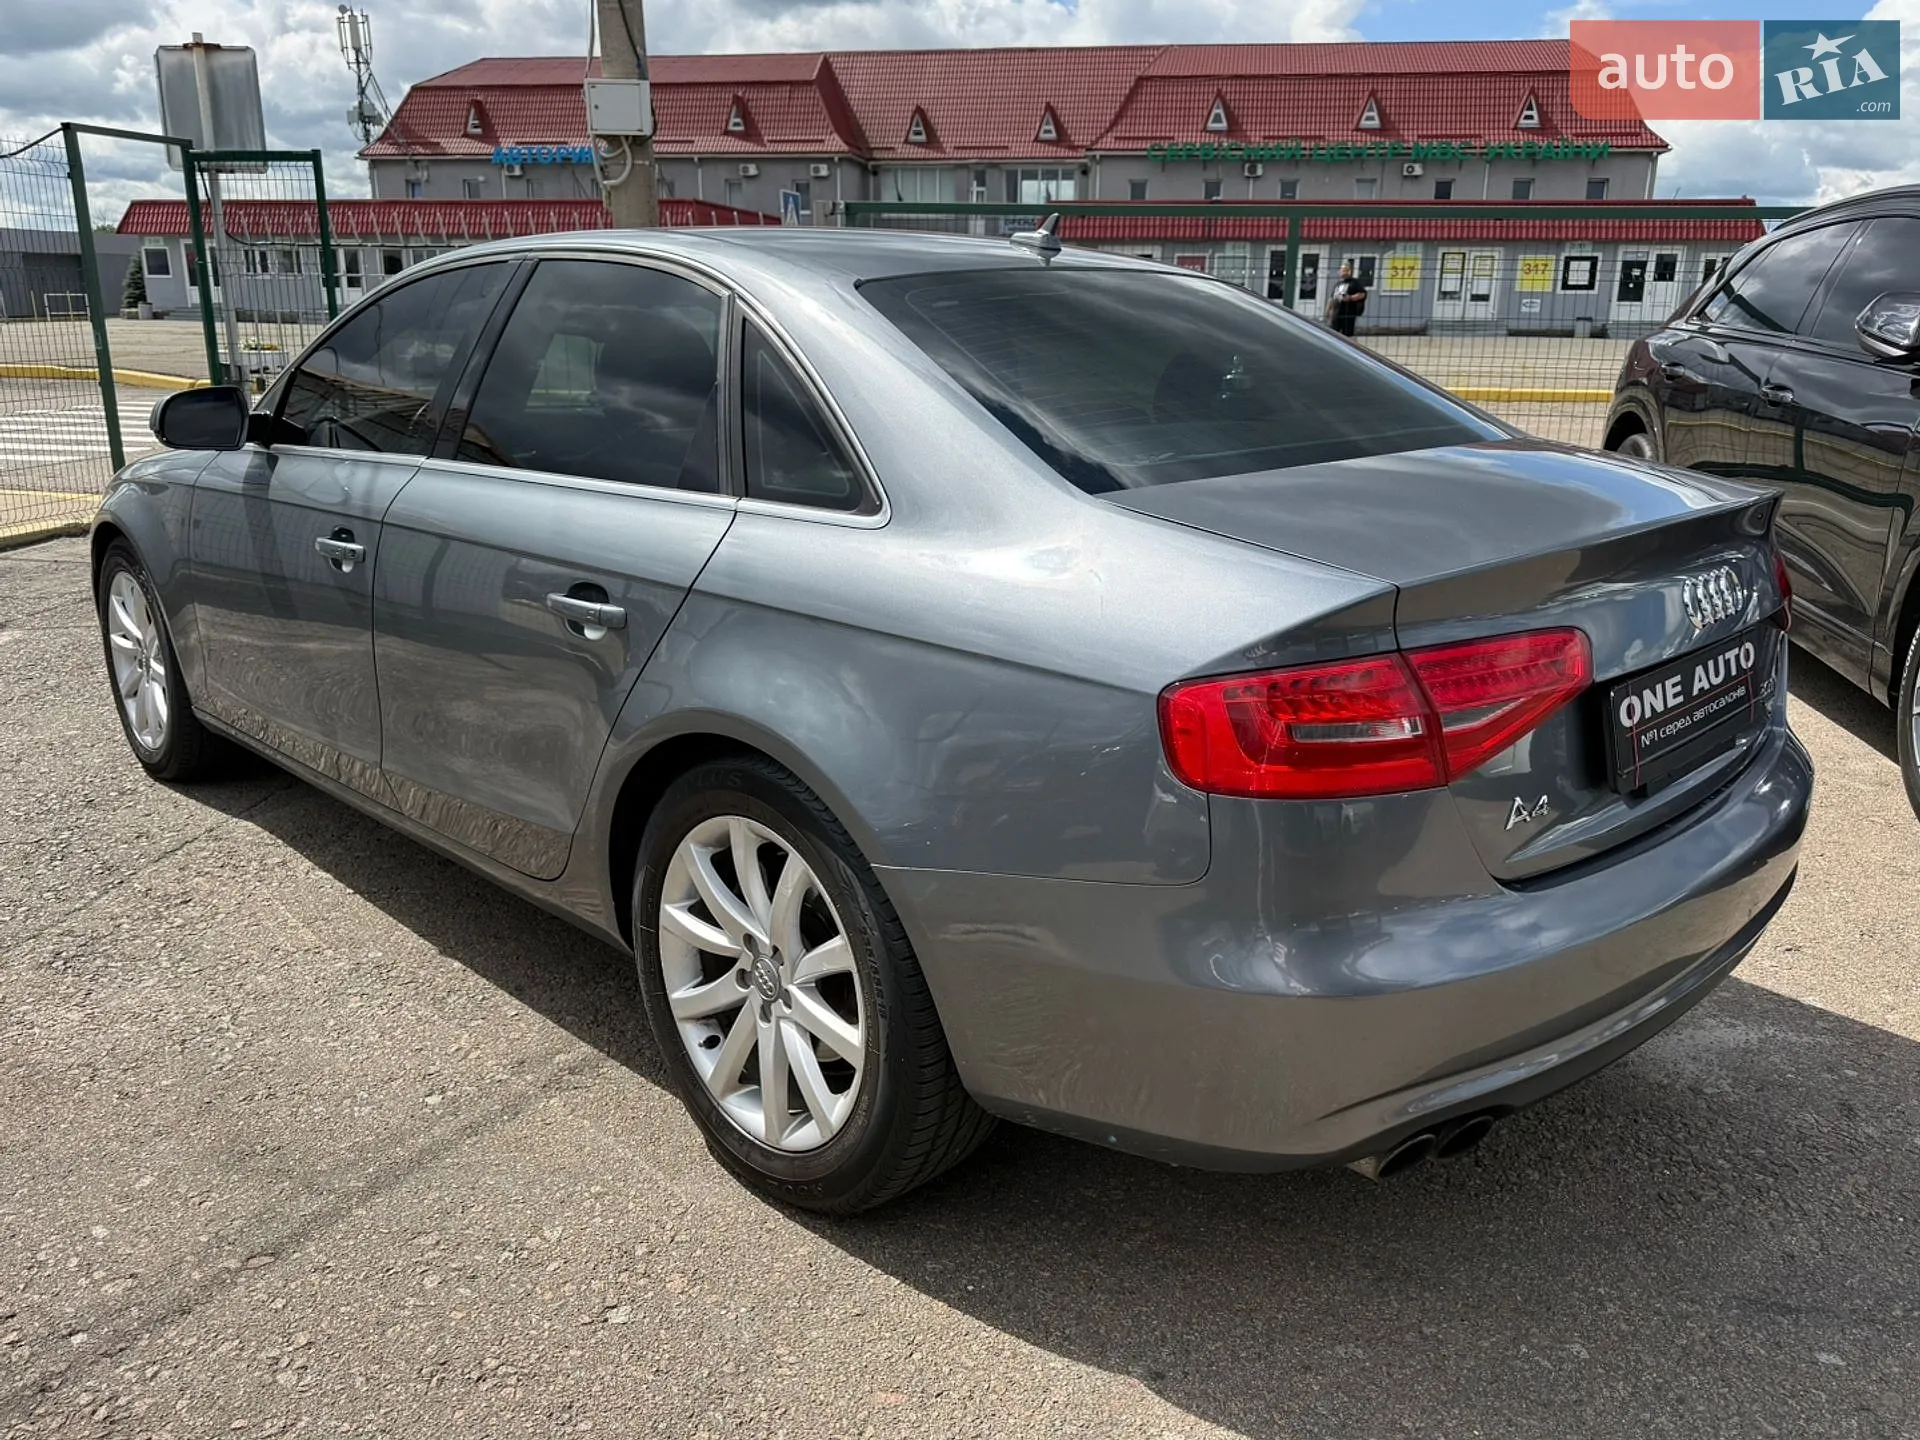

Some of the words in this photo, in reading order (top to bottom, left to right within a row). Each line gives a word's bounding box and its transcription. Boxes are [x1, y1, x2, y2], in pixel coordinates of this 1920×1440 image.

[1147, 136, 1303, 161] СЕРВІСНИЙ
[1313, 142, 1404, 164] ЦЕНТР
[1411, 141, 1473, 161] МВС
[1483, 136, 1610, 161] УКРАЇНИ
[1390, 265, 1415, 278] 317
[1523, 263, 1549, 275] 317
[1619, 674, 1684, 728] ONE
[1692, 641, 1755, 697] AUTO
[1659, 715, 1692, 738] серед
[1692, 685, 1747, 721] автосалонів
[1505, 794, 1551, 831] A4
